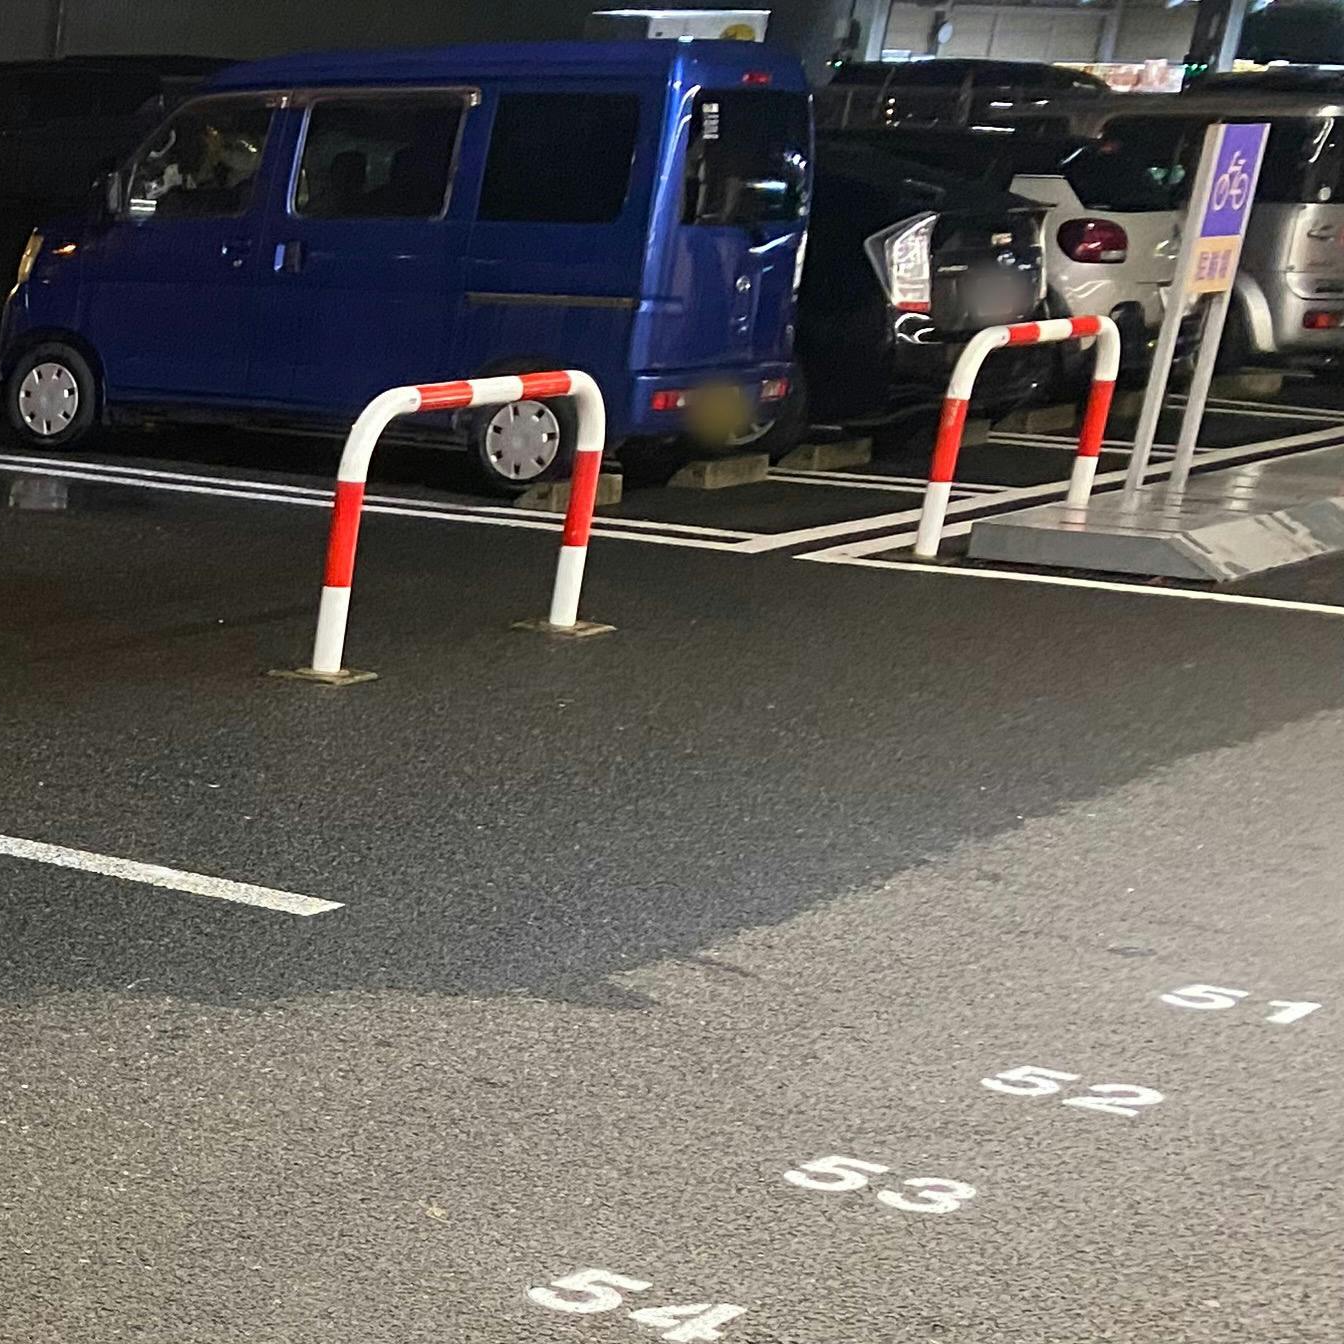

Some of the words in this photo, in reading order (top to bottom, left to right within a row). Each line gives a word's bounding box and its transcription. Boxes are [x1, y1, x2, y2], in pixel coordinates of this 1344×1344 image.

[1161, 985, 1320, 1023] 51
[982, 1066, 1164, 1116] 52
[785, 1156, 976, 1213] 53
[529, 1269, 746, 1342] 54
